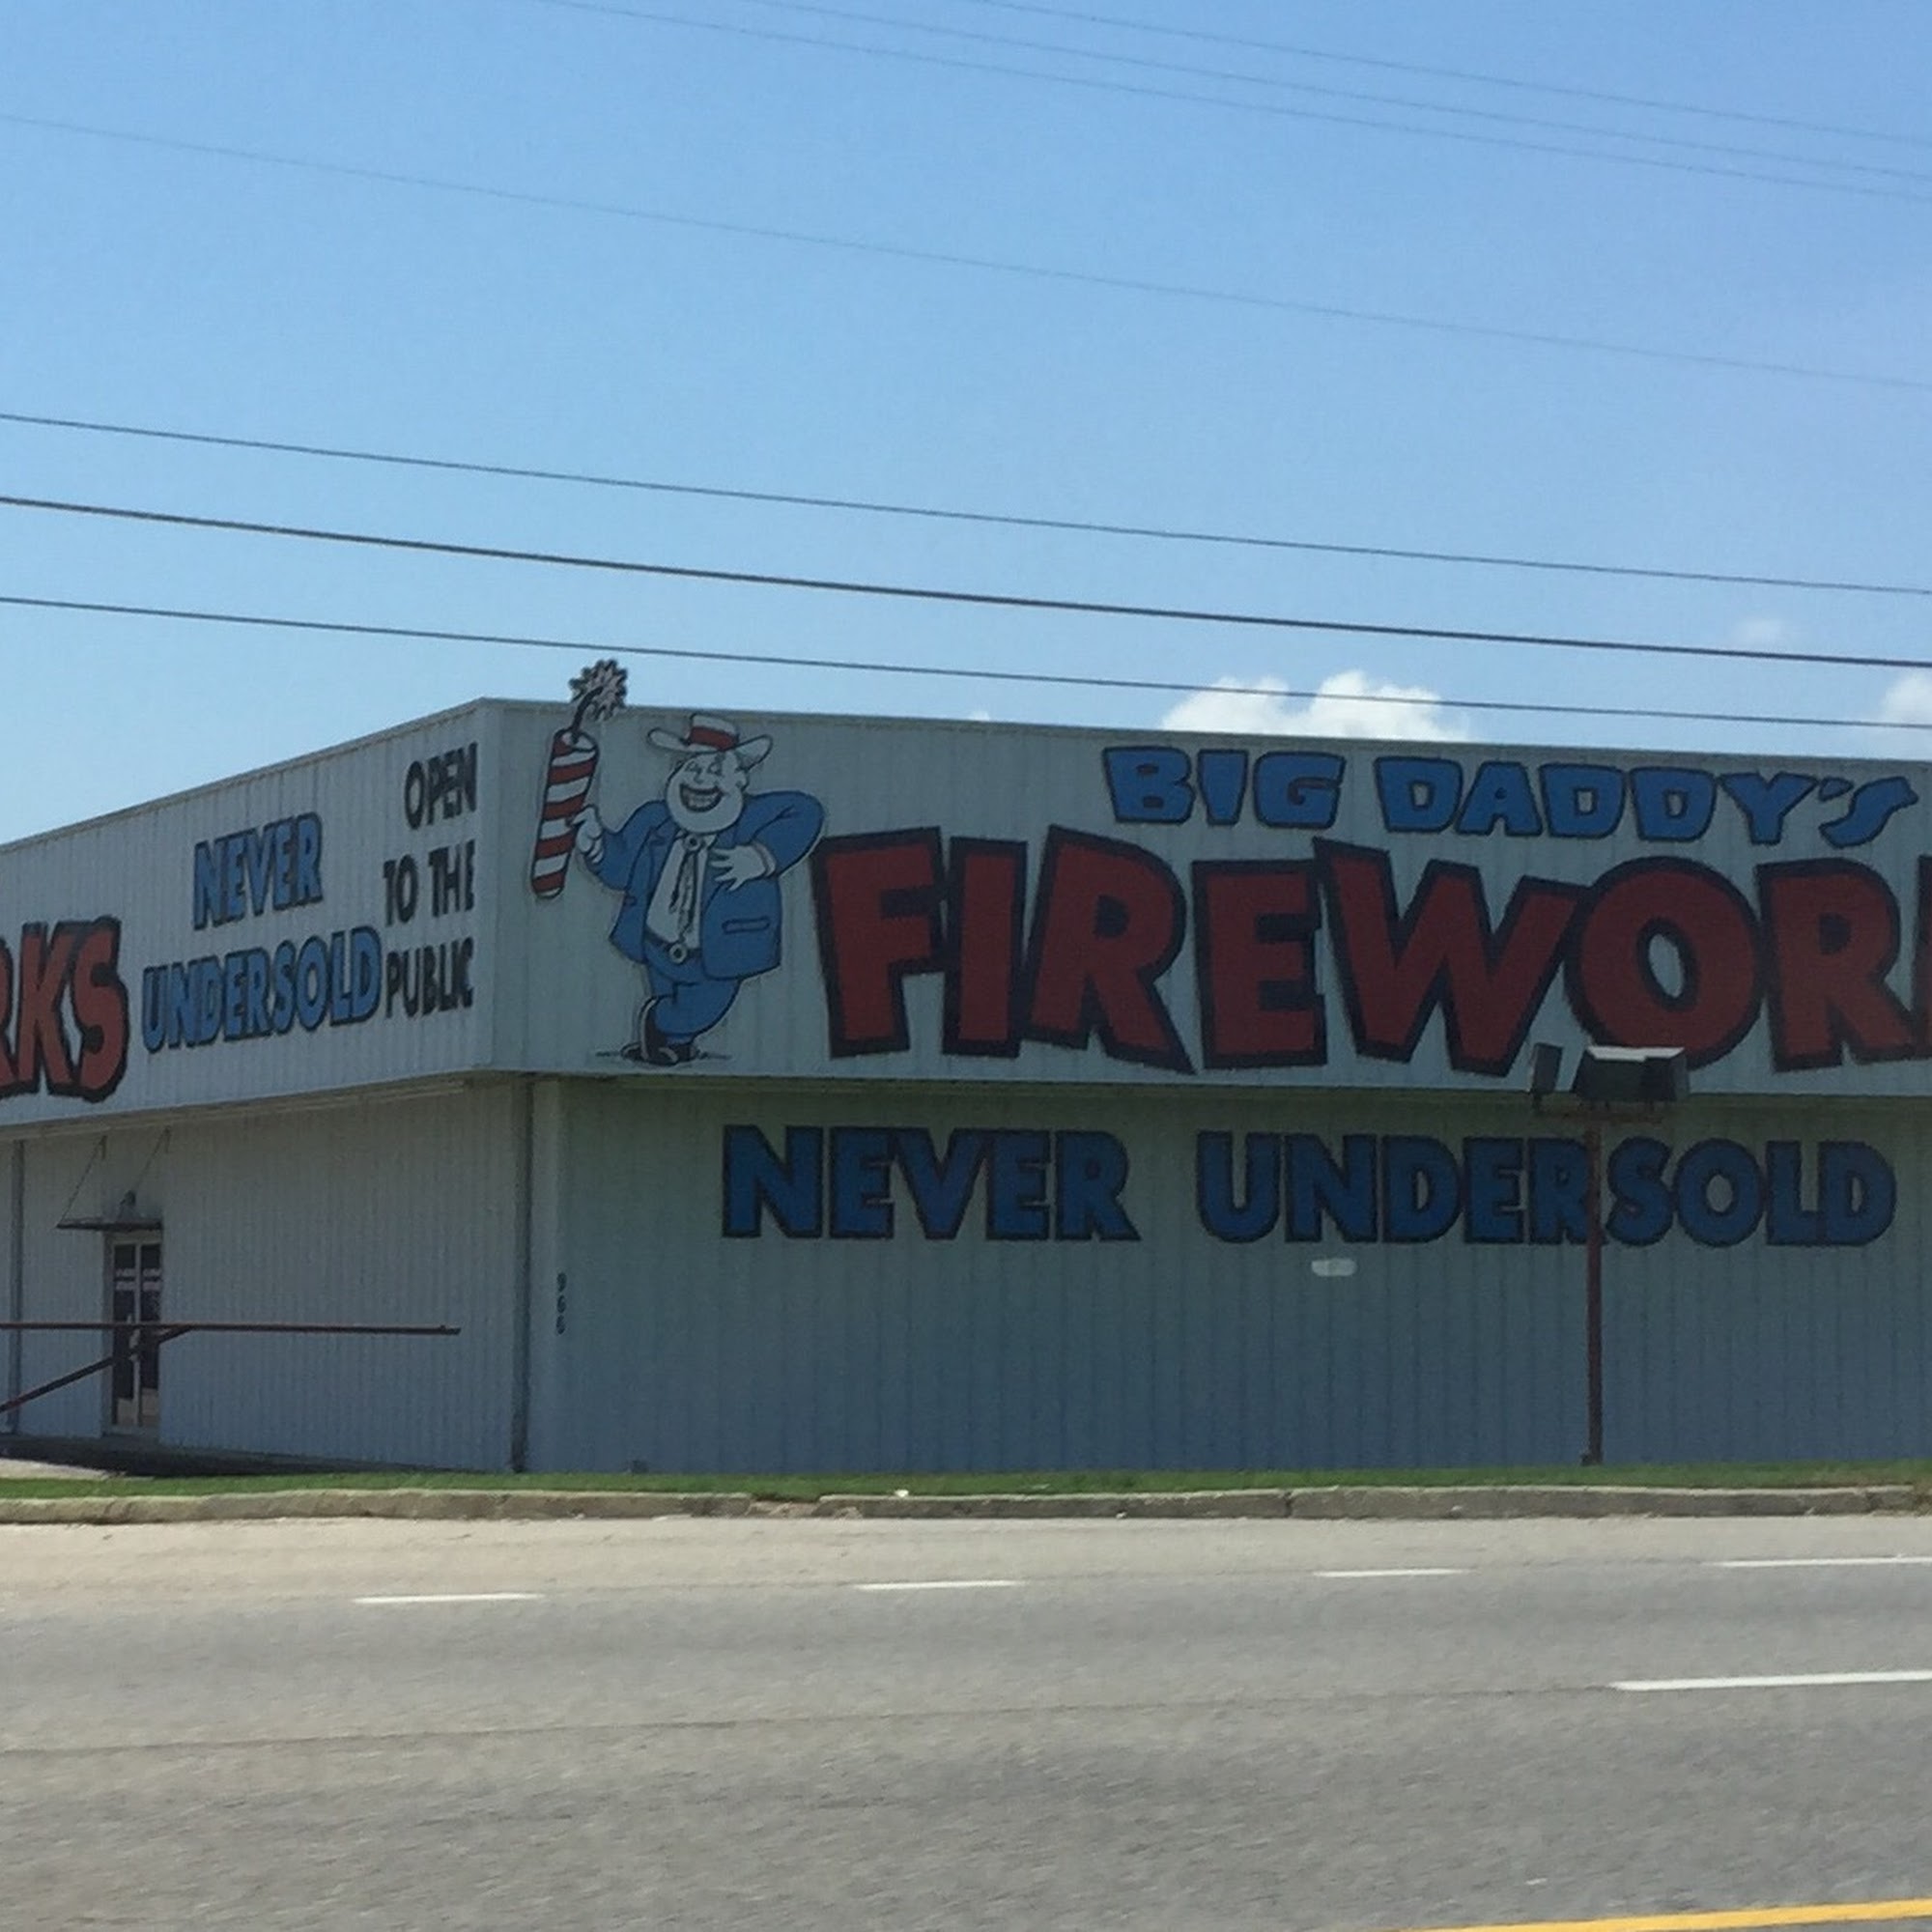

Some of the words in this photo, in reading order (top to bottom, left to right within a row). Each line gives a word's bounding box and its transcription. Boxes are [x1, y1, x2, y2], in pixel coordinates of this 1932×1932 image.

[404, 741, 478, 831] OPEN
[1103, 747, 1346, 828] BIG
[1374, 756, 1918, 848] DADDY'S
[194, 811, 324, 930] NEVER
[383, 854, 419, 927] TO
[428, 838, 476, 919] THE
[142, 924, 384, 1054] UNDERSOLD
[385, 936, 474, 1019] PUBLIC
[811, 825, 1932, 1076] FIREWOR
[722, 1124, 1141, 1242] NEVER
[1197, 1129, 1896, 1246] UNDERSOLD
